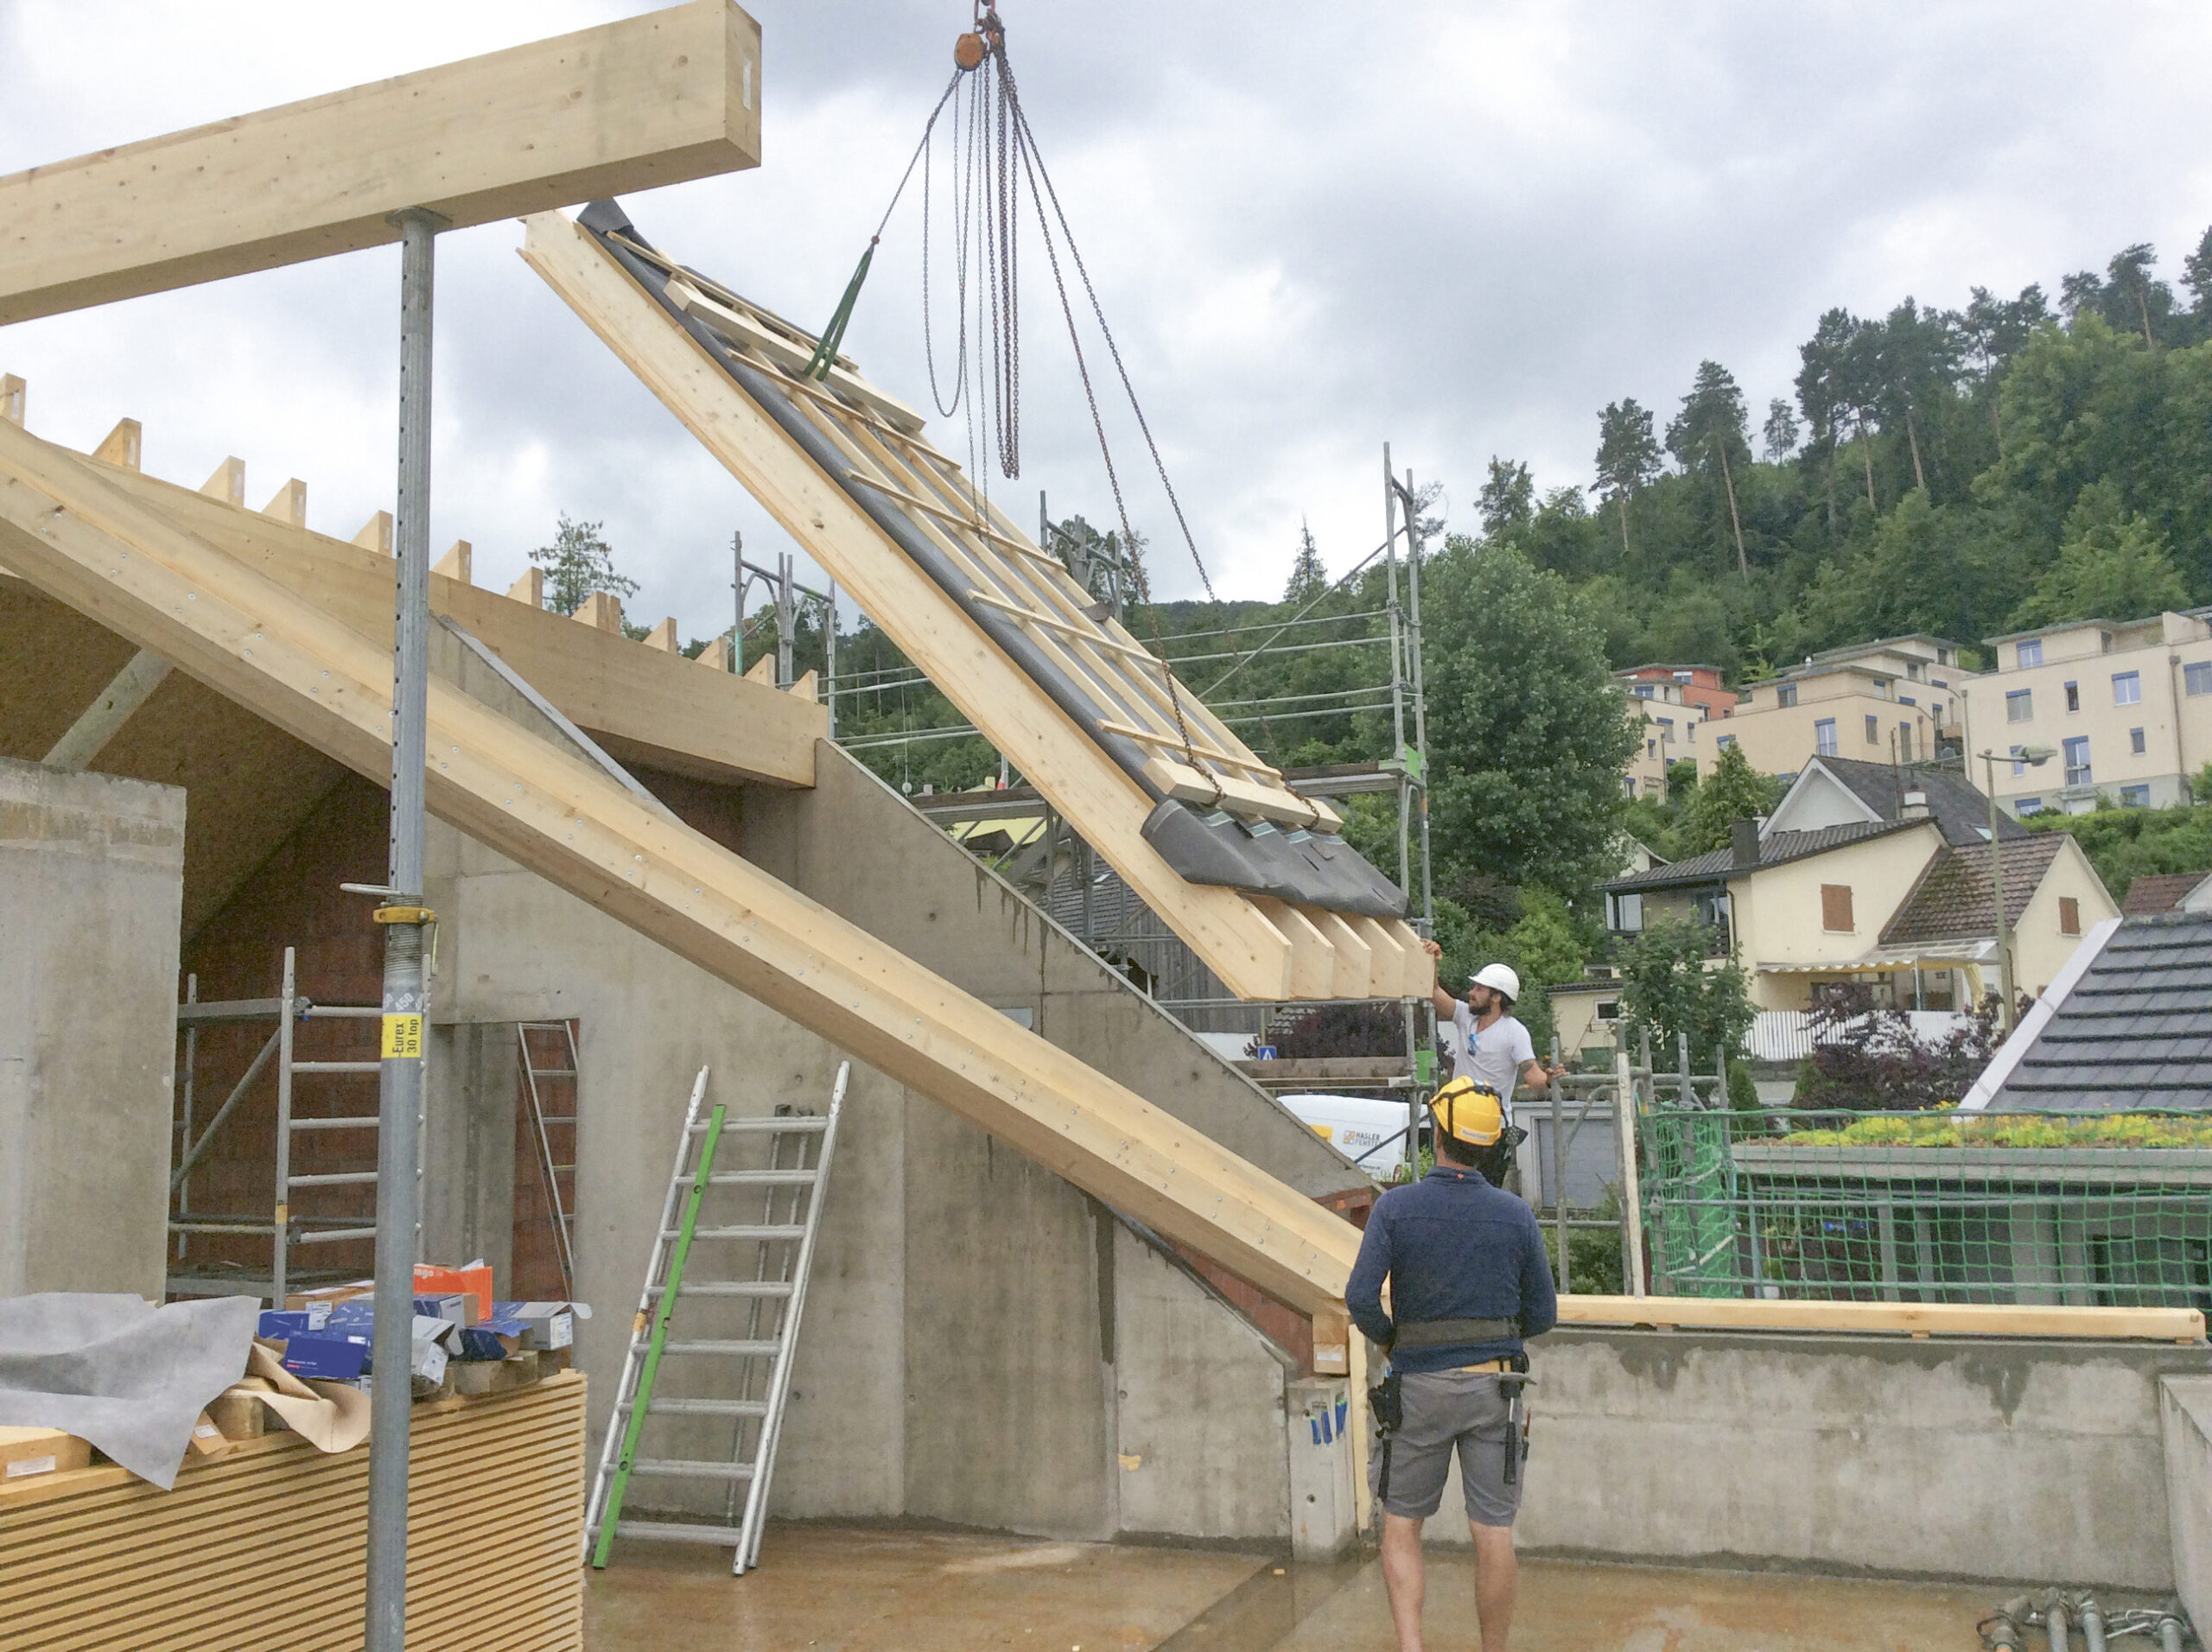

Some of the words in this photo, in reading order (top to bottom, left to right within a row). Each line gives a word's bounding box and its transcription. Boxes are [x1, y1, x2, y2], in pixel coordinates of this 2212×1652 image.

[395, 993, 414, 1011] 450
[408, 1019, 419, 1035] top
[392, 1023, 404, 1053] Eurex
[407, 1039, 417, 1053] 30
[1355, 1131, 1381, 1141] HASLER
